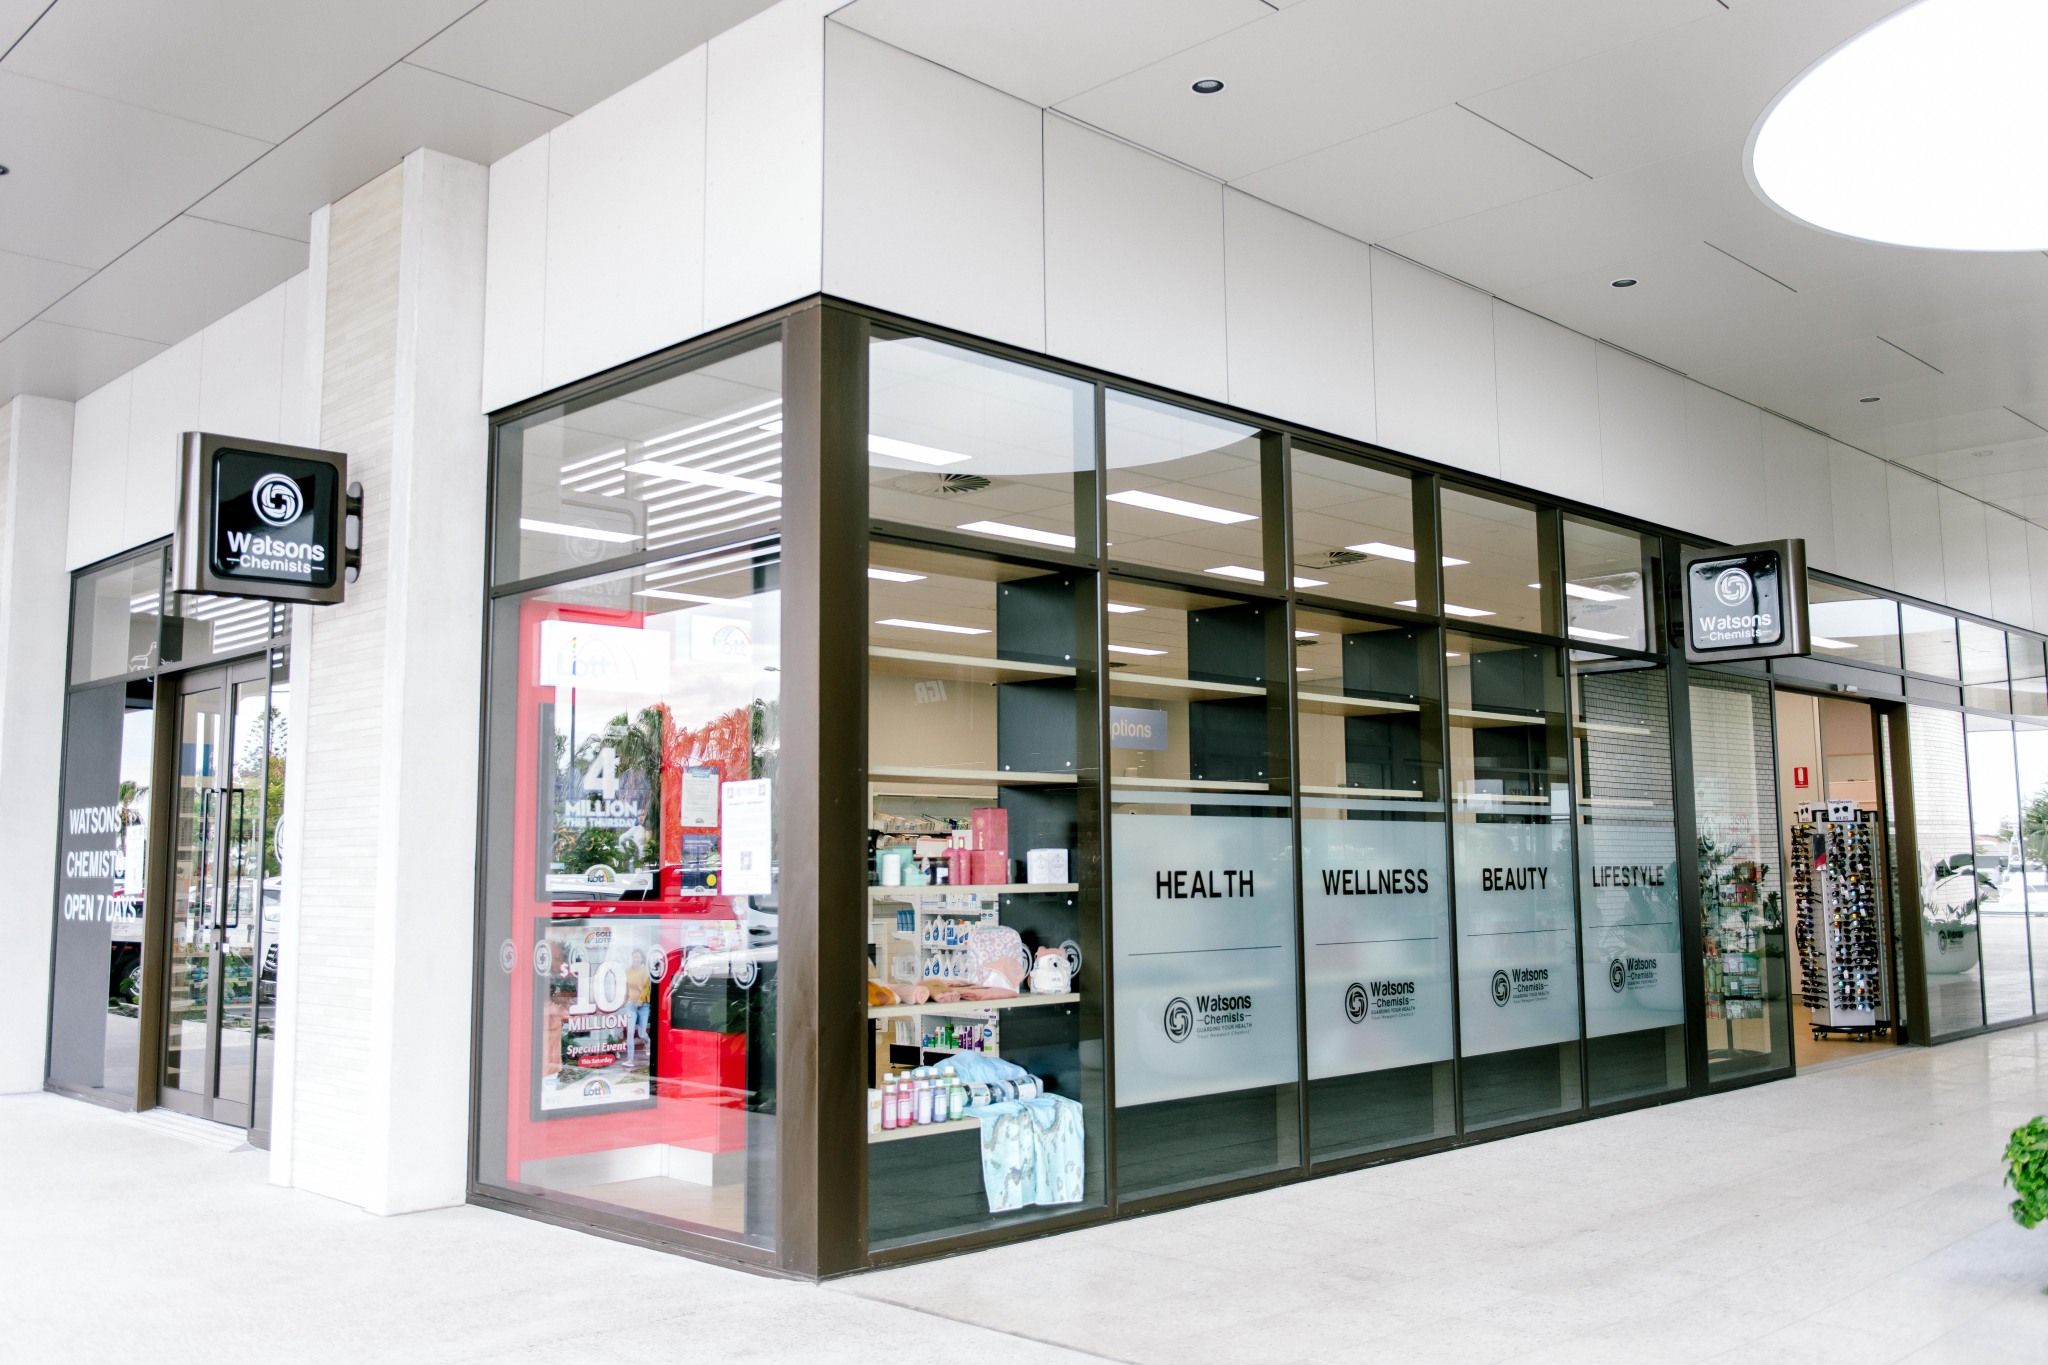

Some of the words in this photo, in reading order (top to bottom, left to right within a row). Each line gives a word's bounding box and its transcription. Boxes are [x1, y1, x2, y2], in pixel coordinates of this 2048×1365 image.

[227, 530, 325, 562] Watsons
[240, 555, 312, 574] Chemists
[1700, 613, 1772, 632] Watsons
[1709, 629, 1761, 641] Chemists
[1110, 720, 1152, 740] ptions
[565, 800, 638, 817] MILLION
[69, 804, 123, 835] WATSONS
[565, 817, 588, 828] THIS
[589, 817, 637, 828] THURSDAY
[1156, 870, 1254, 899] HEALTH
[1322, 868, 1429, 896] WELLNESS
[1482, 867, 1548, 892] BEAUTY
[1592, 866, 1665, 888] LIFESTYLE
[64, 894, 95, 921] OPEN
[97, 895, 104, 921] 7
[105, 896, 137, 922] DAYS
[1627, 958, 1657, 971] Watsons
[1512, 968, 1549, 983] Watsons
[1371, 981, 1415, 997] Watsons
[1517, 983, 1544, 993] Chemists
[1196, 994, 1251, 1013] Watsons
[1376, 996, 1409, 1008] Chemists
[1204, 1012, 1245, 1025] Chemists
[567, 1044, 600, 1057] Special
[602, 1042, 627, 1052] Event
[592, 1057, 613, 1065] Saturday
